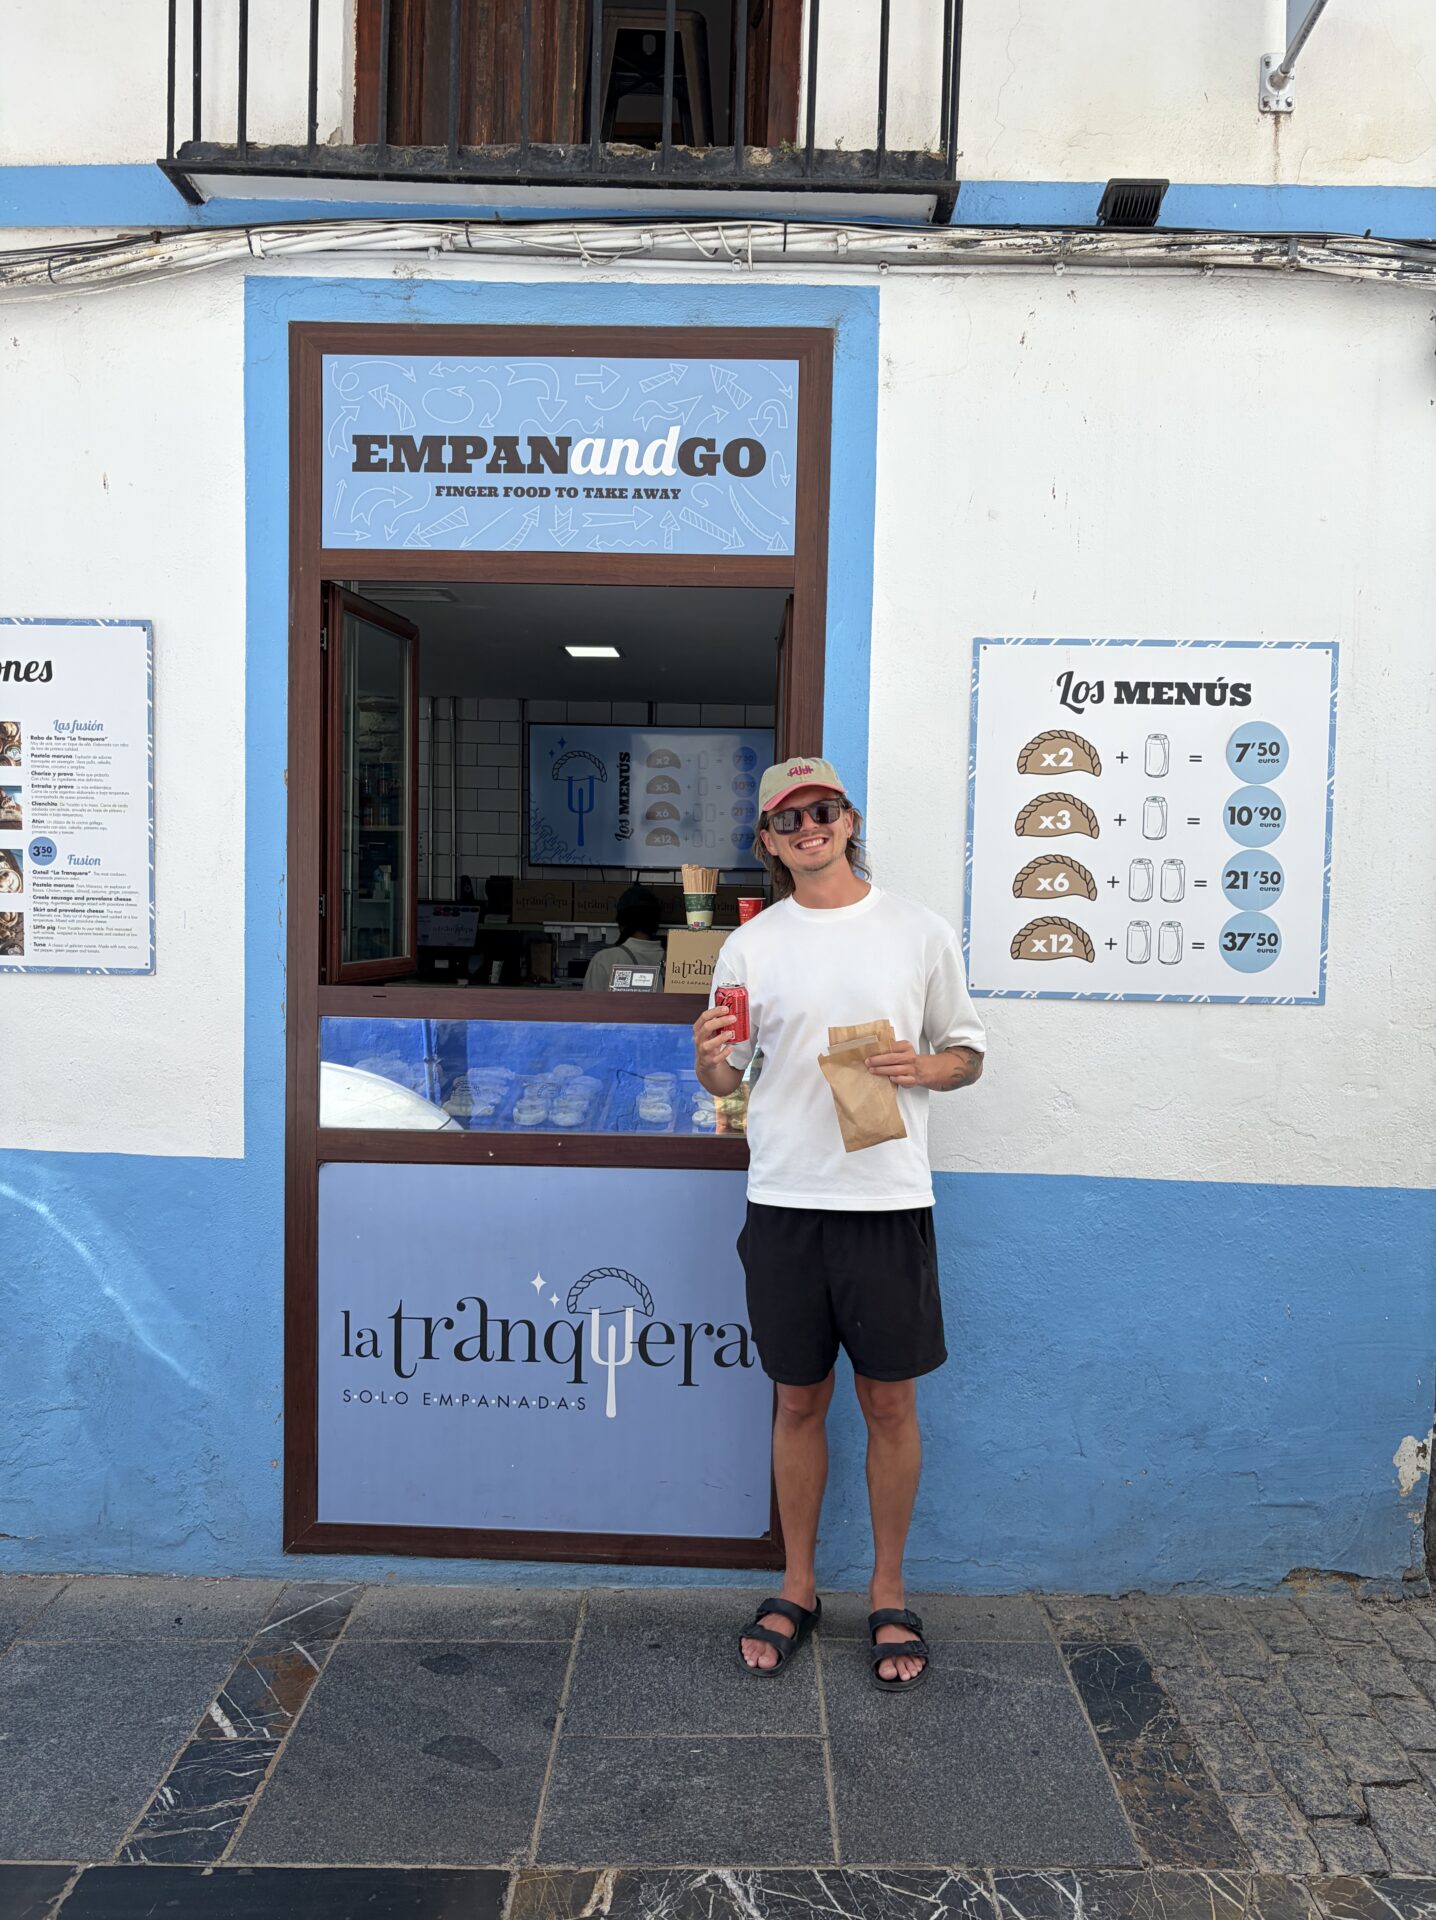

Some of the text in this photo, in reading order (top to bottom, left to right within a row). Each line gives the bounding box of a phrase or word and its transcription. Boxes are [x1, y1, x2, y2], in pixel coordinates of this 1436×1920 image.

[352, 425, 767, 478] EMPANandGO
[435, 485, 681, 500] FINGER FOOD TO TAKE AWAY
[0, 660, 53, 683] nes
[1056, 670, 1253, 715] Los MENÚS
[70, 719, 104, 734] fusión
[656, 755, 670, 765] x2
[1040, 748, 1074, 768] x2
[615, 751, 635, 842] Los MENÚS
[656, 782, 670, 792] x3
[655, 809, 670, 818] x6
[1038, 809, 1072, 830] x3
[654, 834, 673, 844] x12
[67, 854, 102, 866] Fusion
[1036, 872, 1070, 892] x6
[1030, 934, 1074, 954] x12
[672, 961, 681, 974] la
[340, 1309, 383, 1359] la
